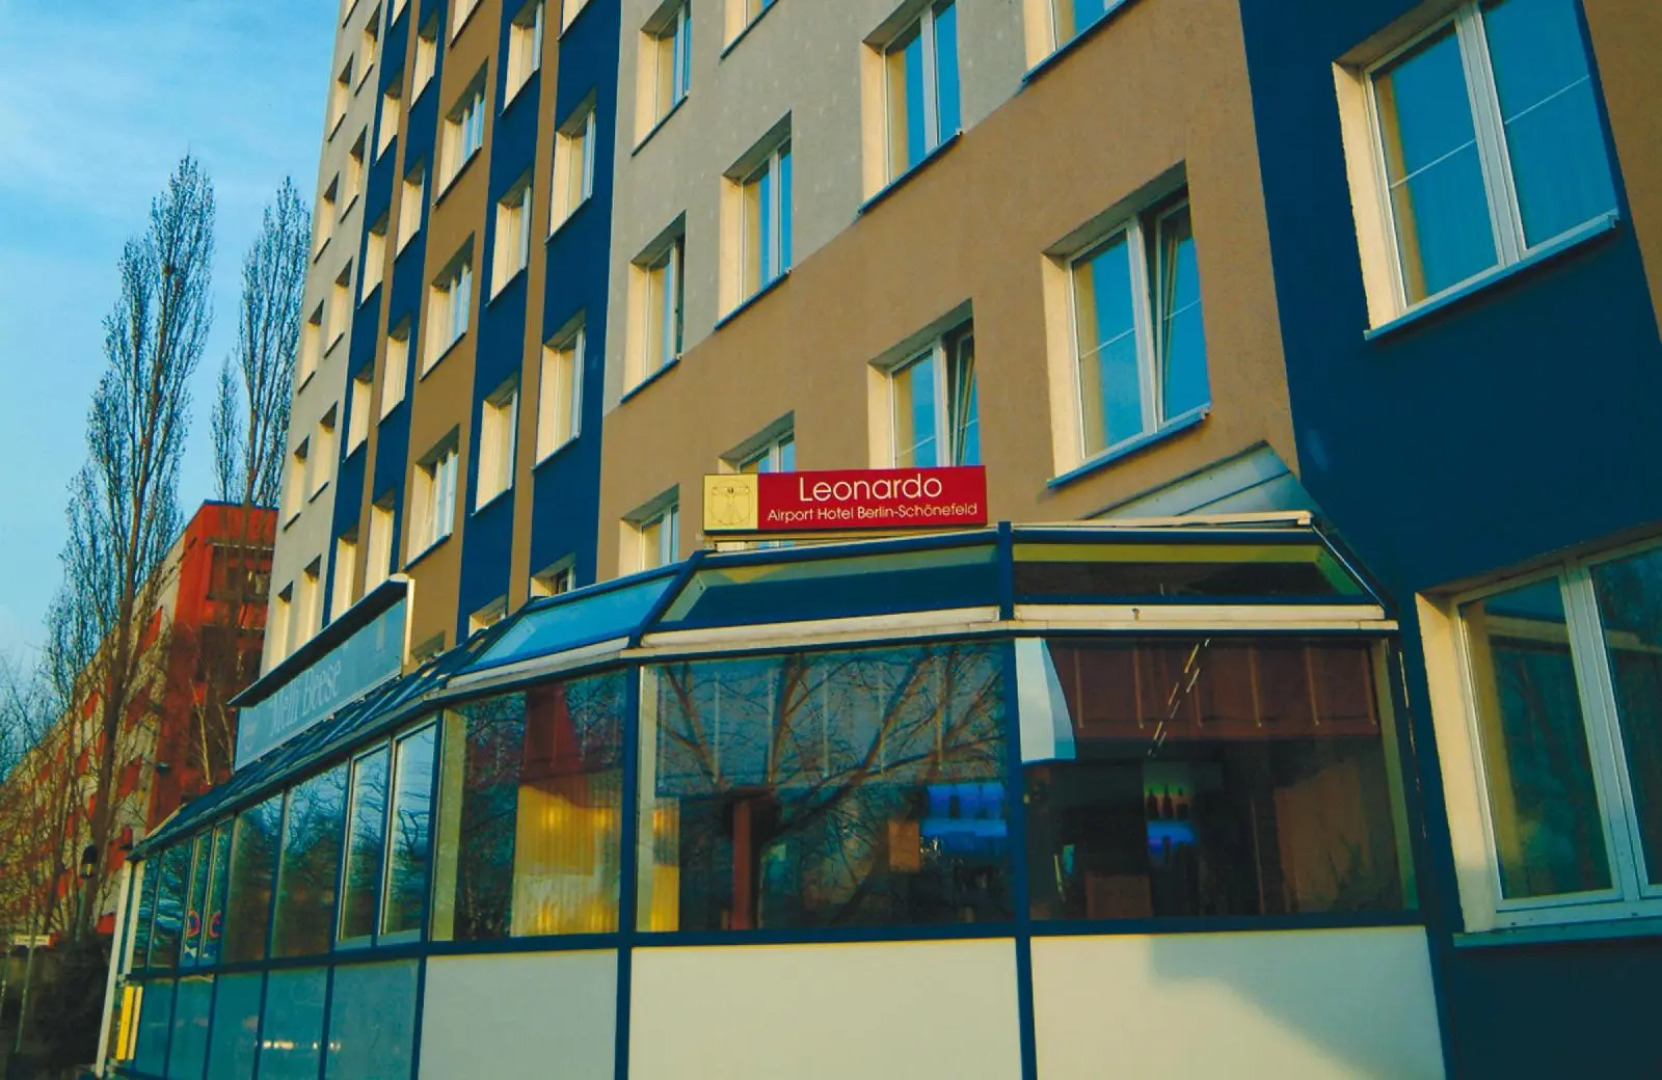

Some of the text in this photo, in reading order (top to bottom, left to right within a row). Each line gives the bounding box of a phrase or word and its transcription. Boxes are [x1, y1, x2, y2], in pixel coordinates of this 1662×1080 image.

[800, 474, 942, 502] Leonardo
[768, 502, 978, 523] Airport Hotel Berlin-Schönefeld
